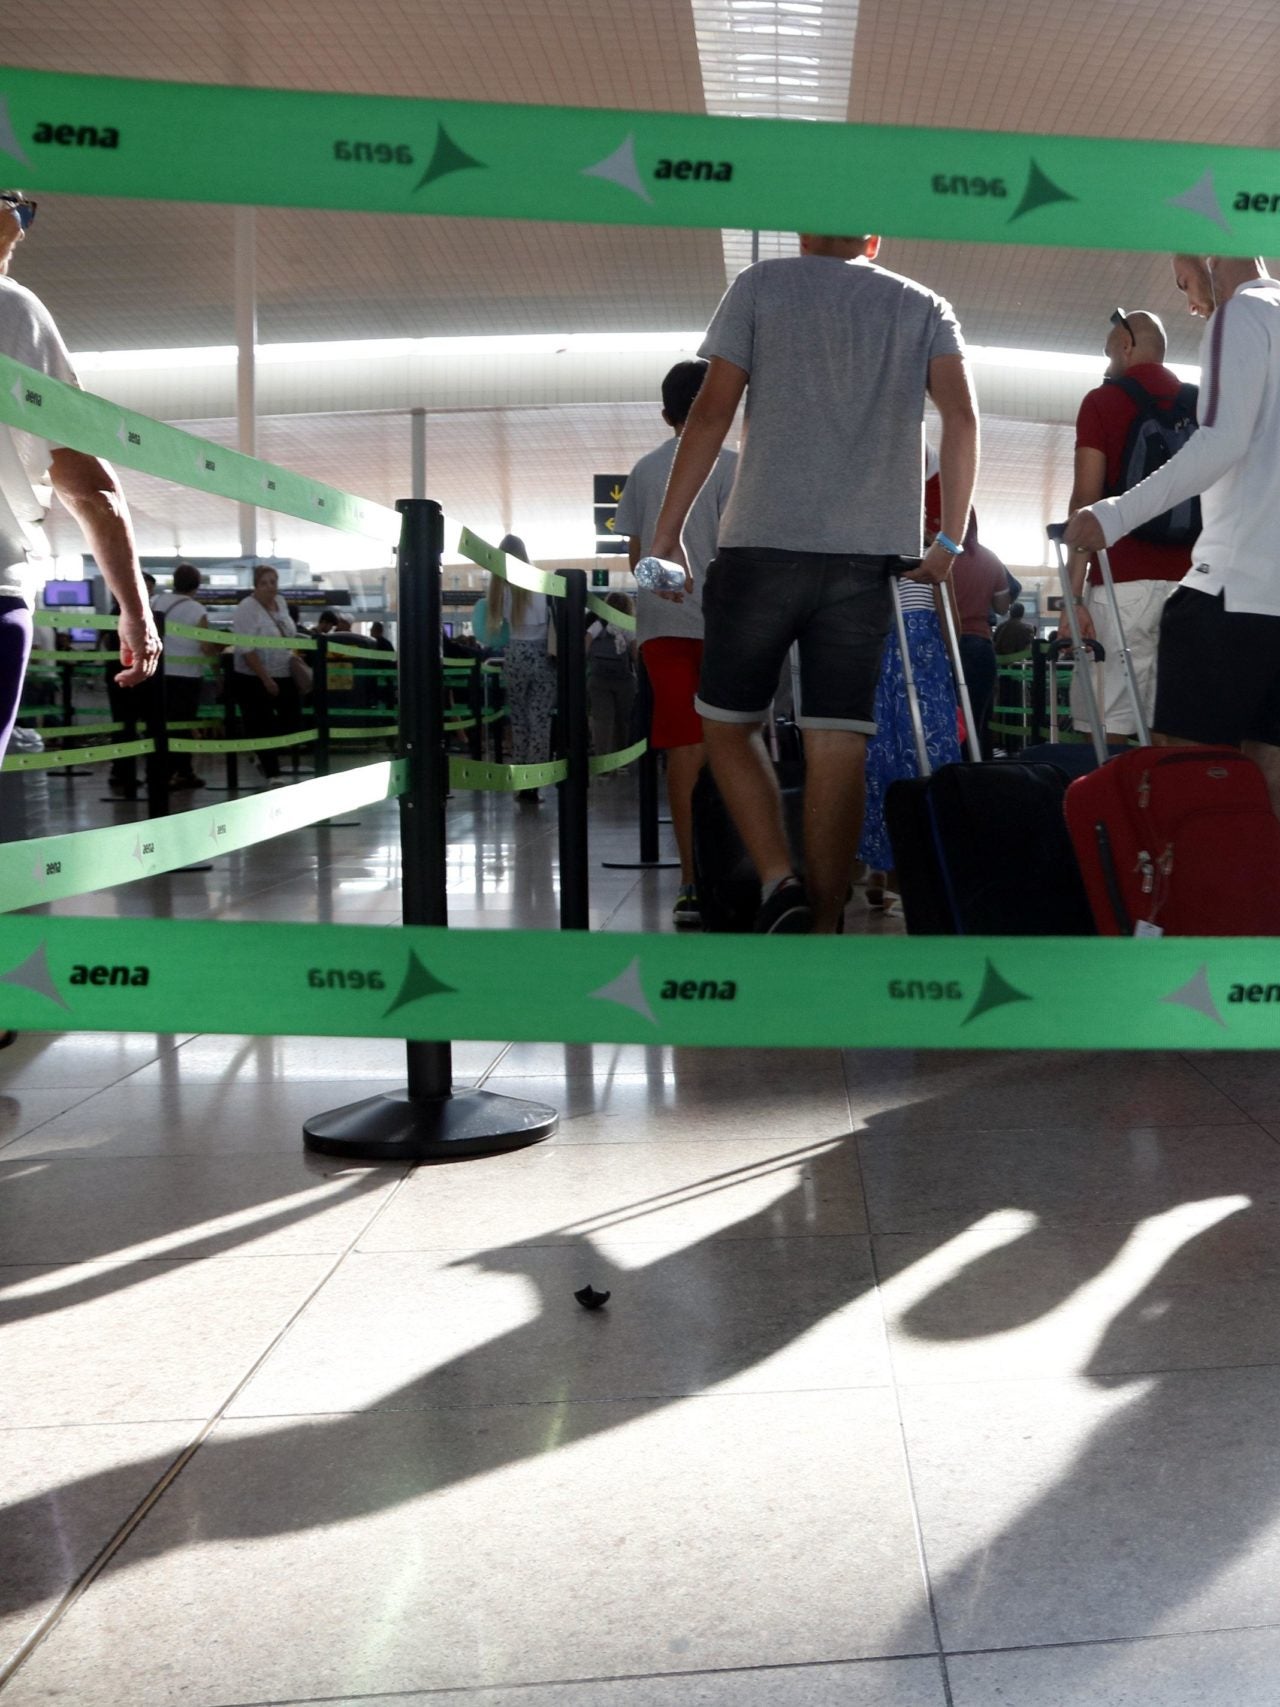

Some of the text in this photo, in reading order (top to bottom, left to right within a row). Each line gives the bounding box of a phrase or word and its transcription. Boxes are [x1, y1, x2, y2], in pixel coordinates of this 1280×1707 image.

[32, 121, 120, 150] aena
[653, 158, 734, 183] aena
[70, 964, 150, 988] aena
[660, 979, 737, 1002] aena
